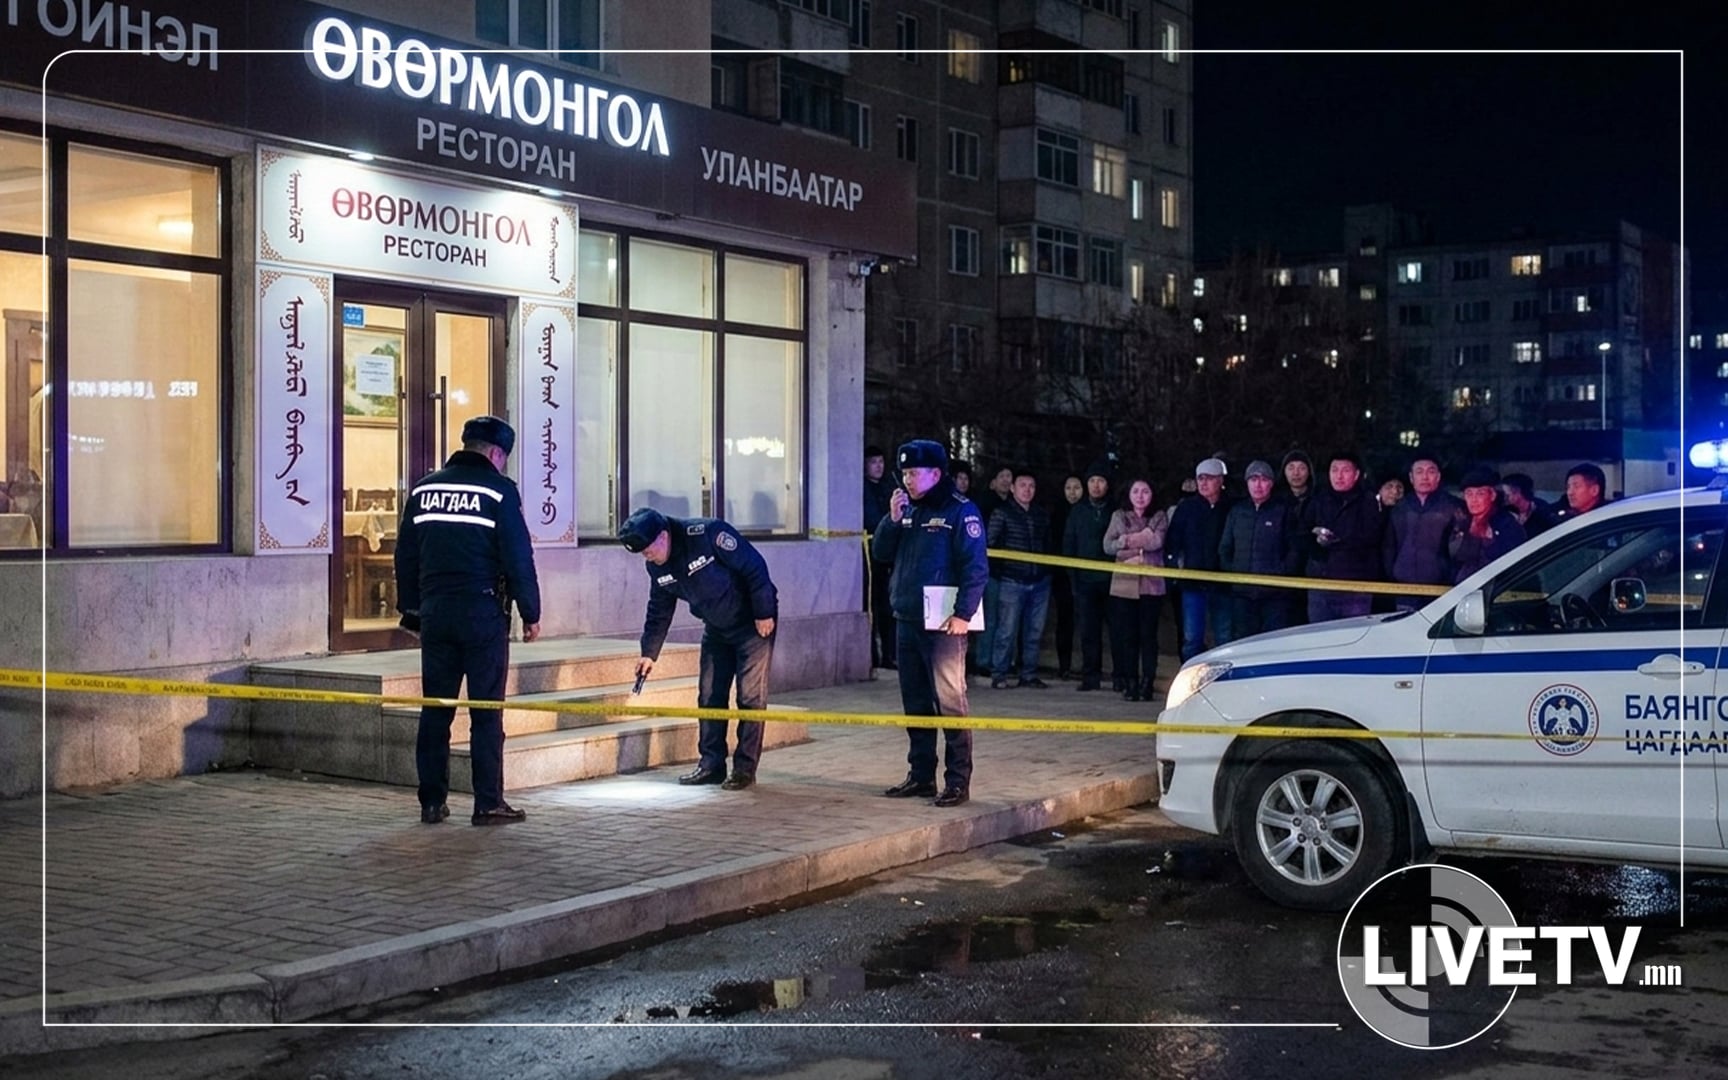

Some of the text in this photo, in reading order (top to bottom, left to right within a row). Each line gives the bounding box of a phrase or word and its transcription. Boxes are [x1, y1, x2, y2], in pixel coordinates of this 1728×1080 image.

[311, 17, 670, 156] ӨВӨРМОНГОЛ
[417, 117, 576, 182] РЕСТОРАН
[701, 147, 863, 212] УЛАНБААТАР
[332, 187, 531, 247] ӨВӨРМОНГОЛ
[384, 235, 487, 267] РЕСТОРАН
[420, 492, 481, 512] ЦАГДАА
